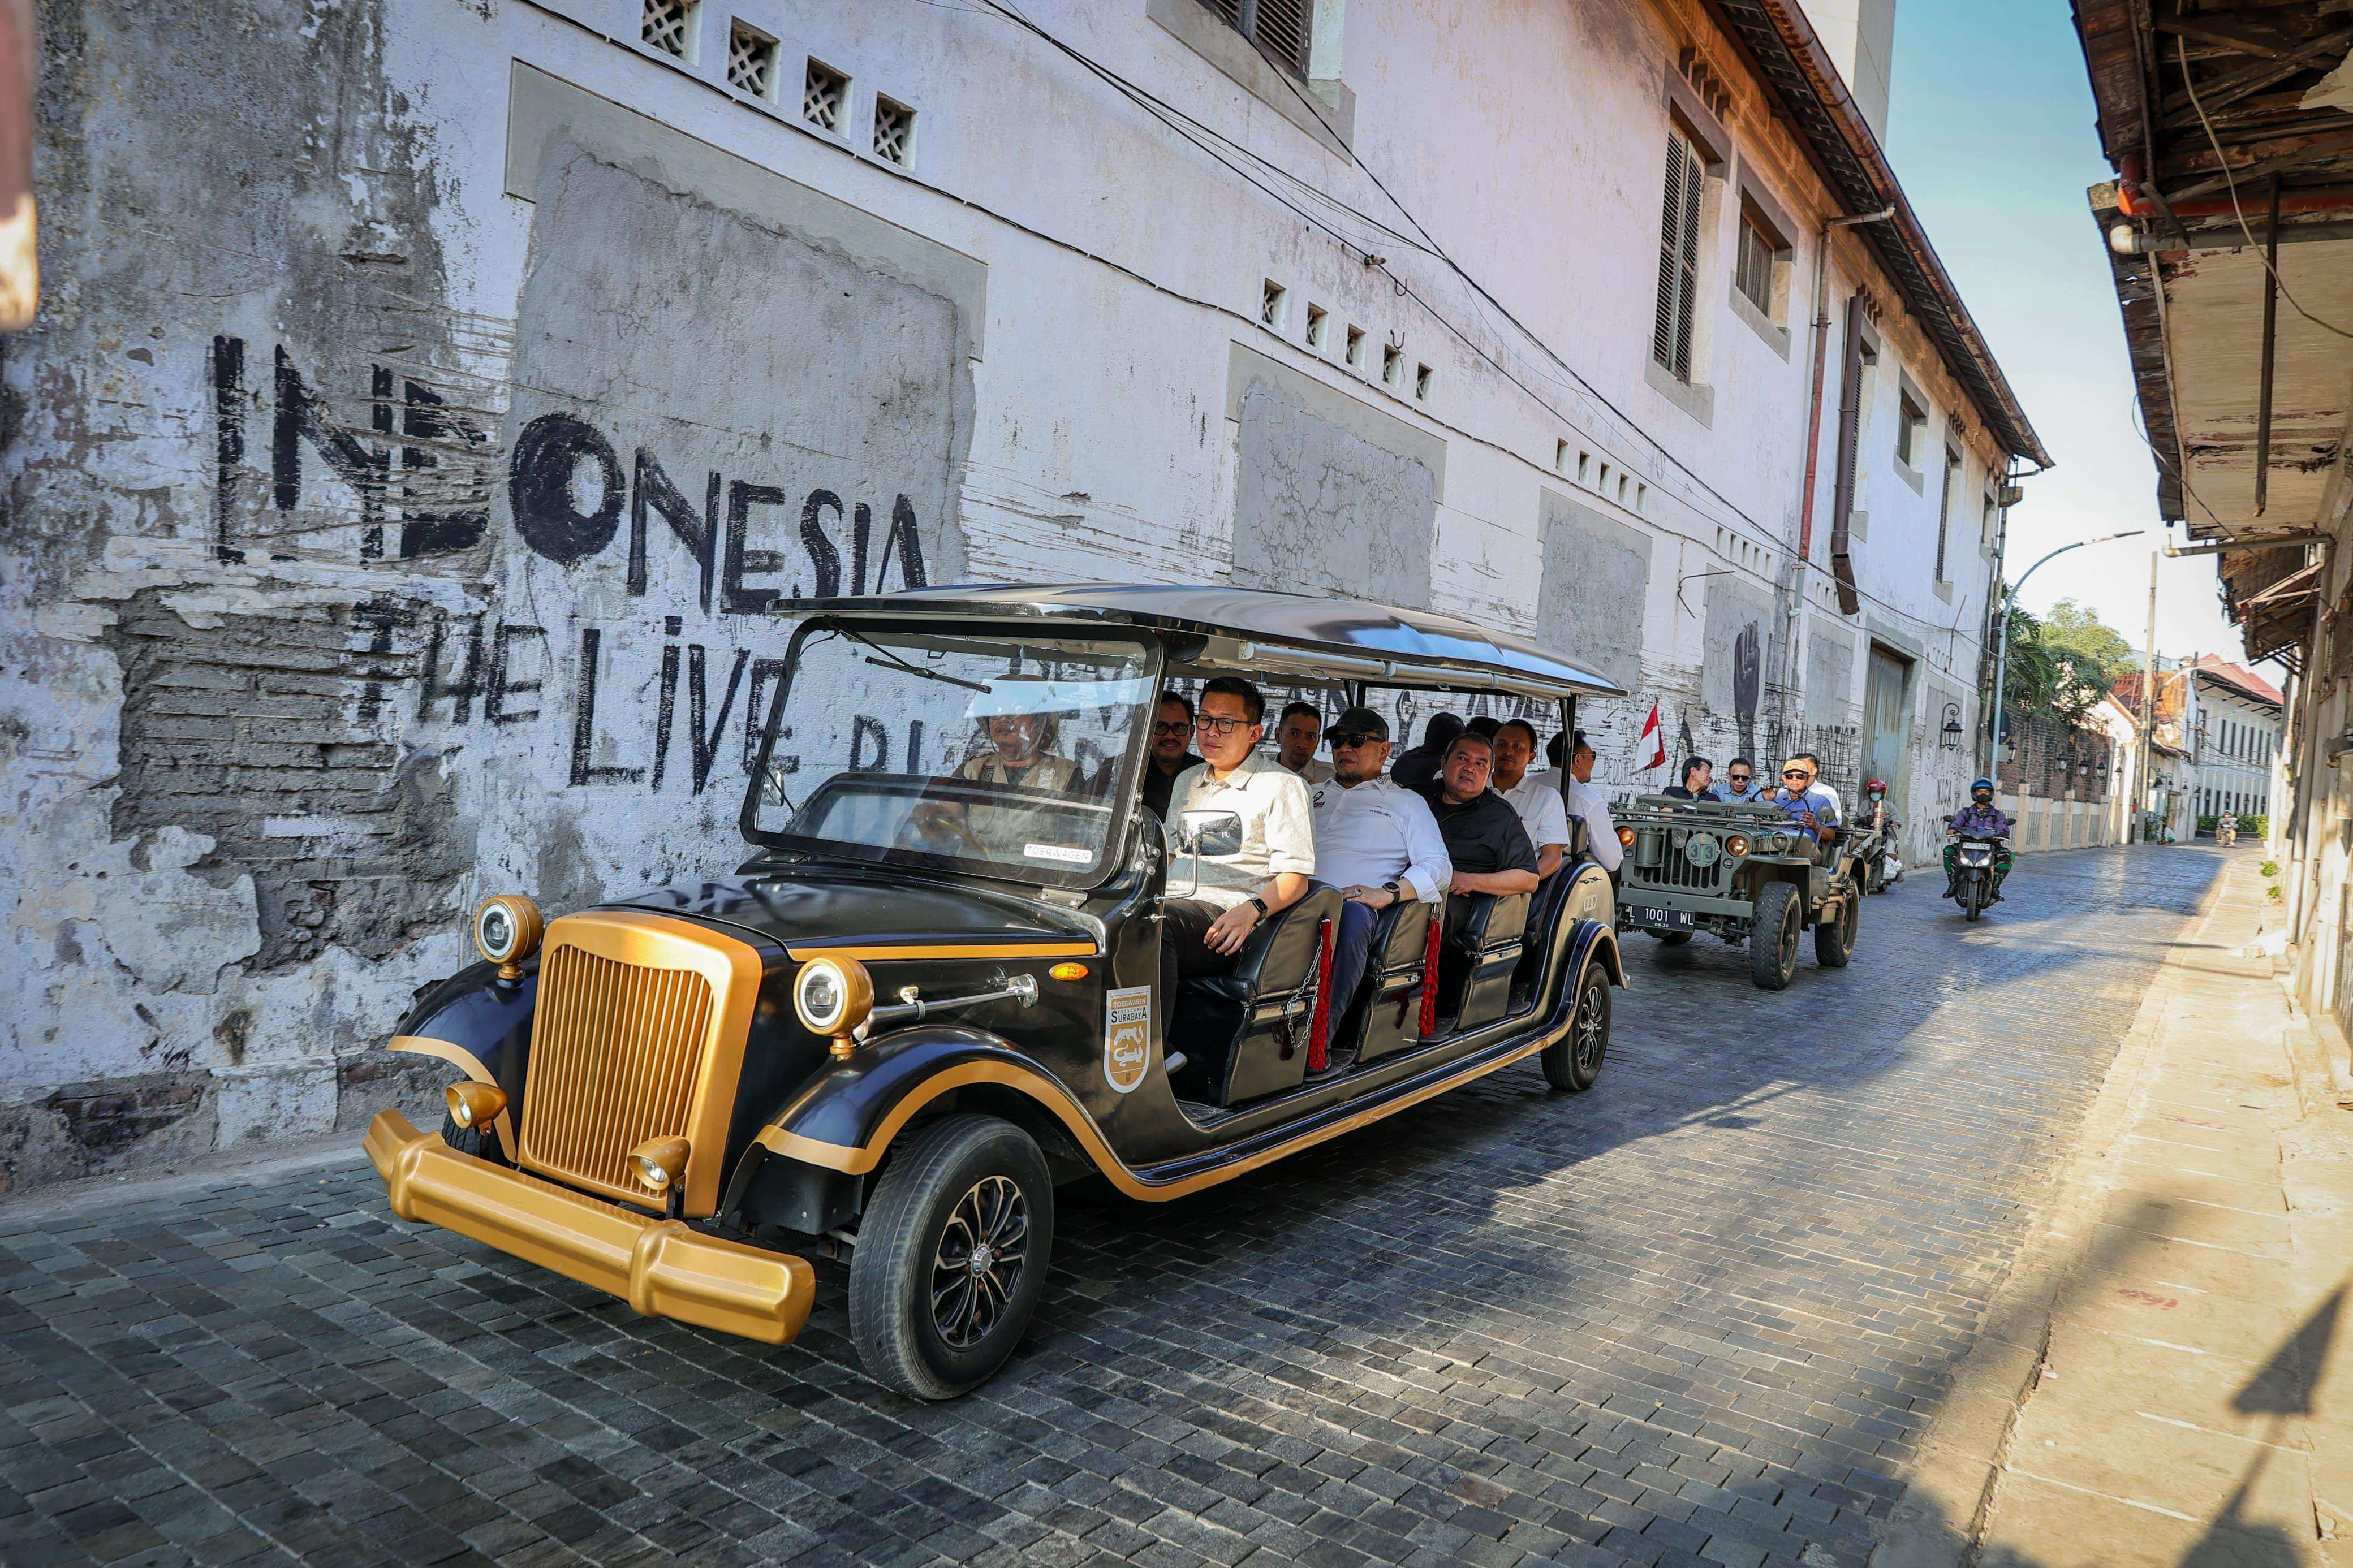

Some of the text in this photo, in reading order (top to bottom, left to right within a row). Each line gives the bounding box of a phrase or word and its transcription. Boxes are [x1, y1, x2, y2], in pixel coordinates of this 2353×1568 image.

[210, 335, 928, 615] INDONESIA
[350, 597, 550, 727] THE
[1027, 846, 1090, 860] TOERWAGEN
[1629, 906, 1693, 926] L 1001 WL
[1113, 997, 1147, 1008] TOERWAGEN
[1111, 1007, 1147, 1023] SURABAYA
